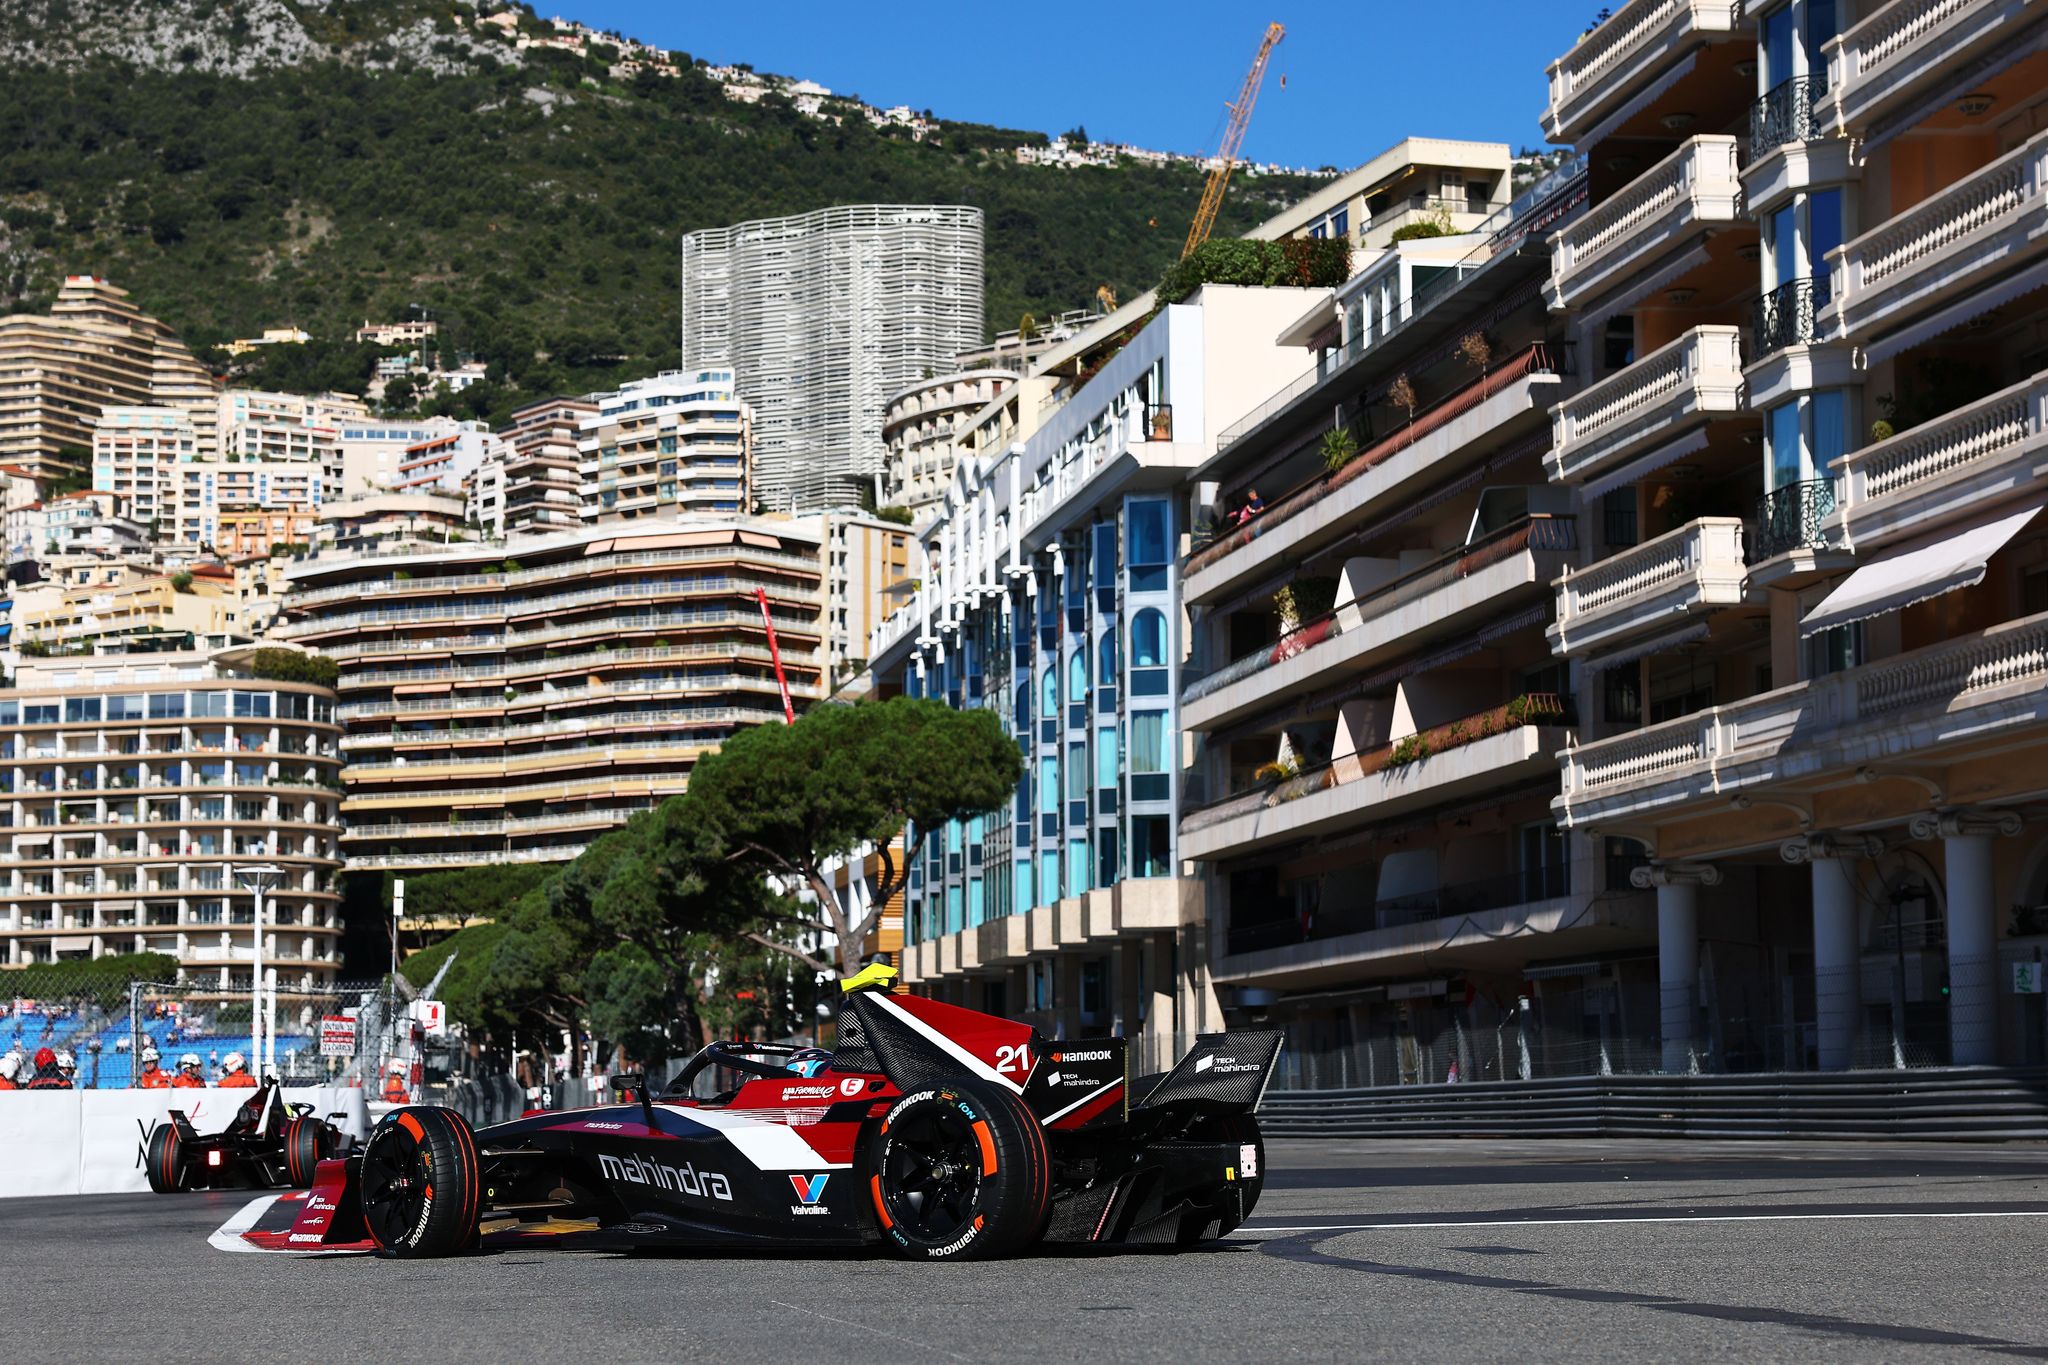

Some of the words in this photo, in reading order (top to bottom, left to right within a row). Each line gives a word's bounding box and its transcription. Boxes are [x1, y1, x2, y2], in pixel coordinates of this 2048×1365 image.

[995, 1043, 1030, 1073] 21
[1215, 1057, 1235, 1065] TECH
[1214, 1063, 1260, 1073] mahindra
[1063, 1078, 1100, 1087] mahindra
[598, 1152, 733, 1201] mahindra
[791, 1205, 829, 1215] Valvoline
